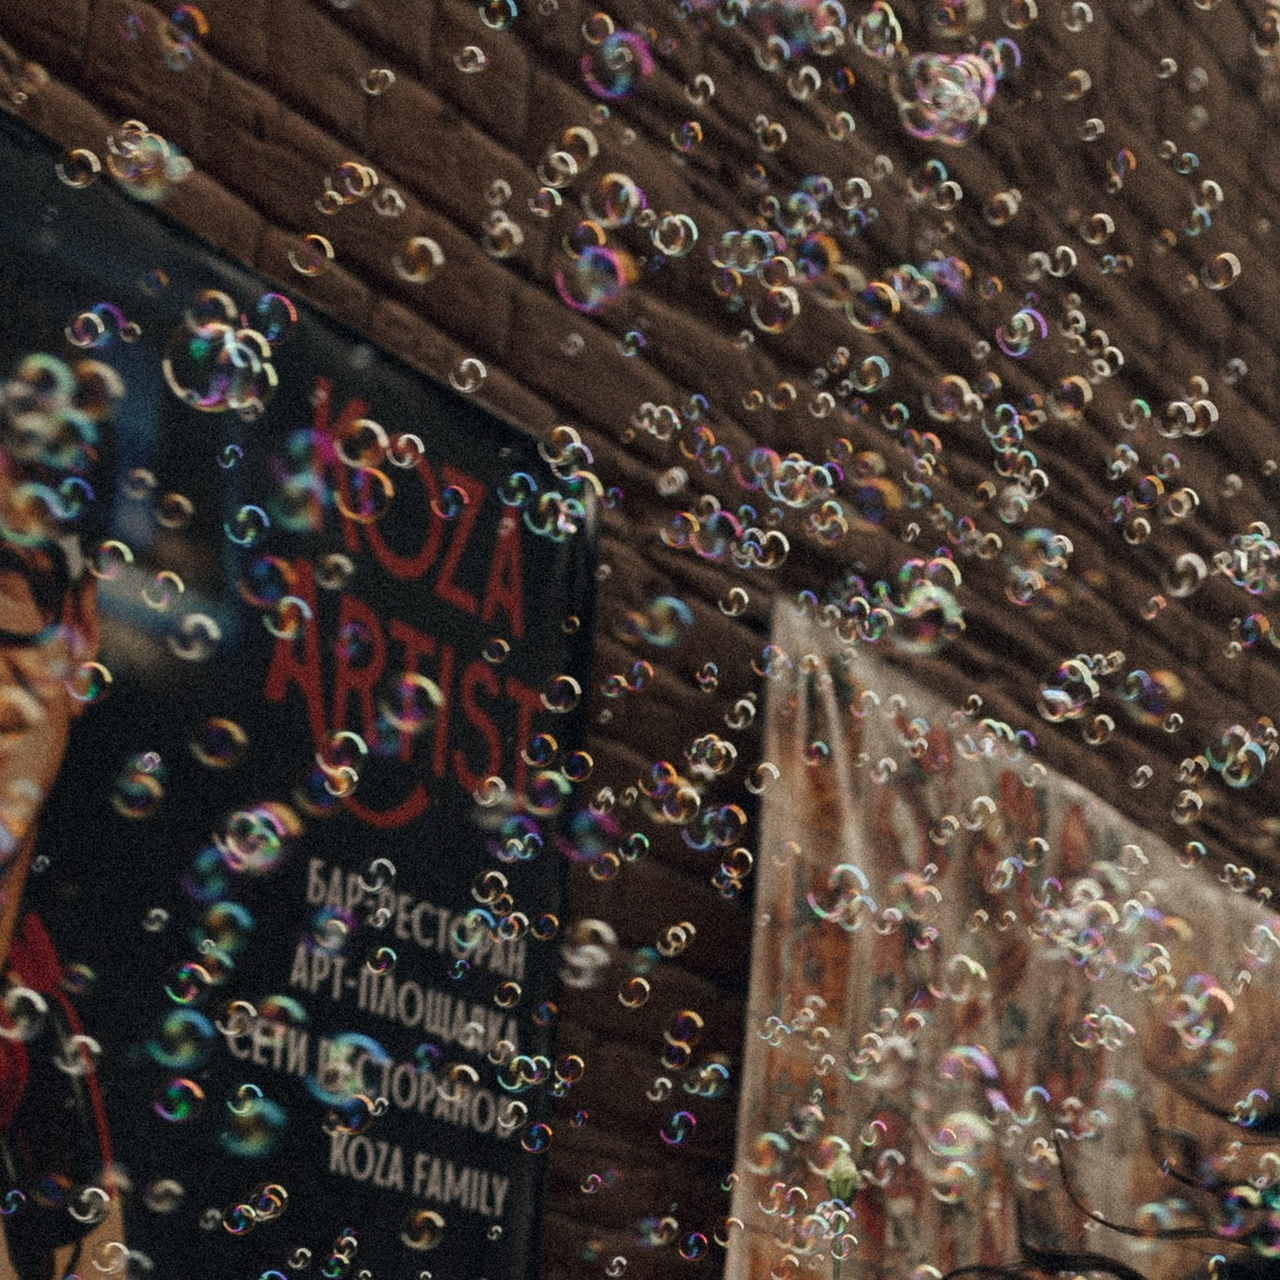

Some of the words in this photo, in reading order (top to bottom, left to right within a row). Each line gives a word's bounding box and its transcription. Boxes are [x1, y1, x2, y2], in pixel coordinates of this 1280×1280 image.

[311, 376, 524, 639] KOZA
[264, 558, 546, 828] ARTIST
[306, 857, 526, 980] БАР-РЕСТОРАН
[290, 943, 519, 1058] АРТ-ПЛОЩАДКА
[329, 1132, 404, 1191] KOZA
[413, 1152, 510, 1218] FAMILY
